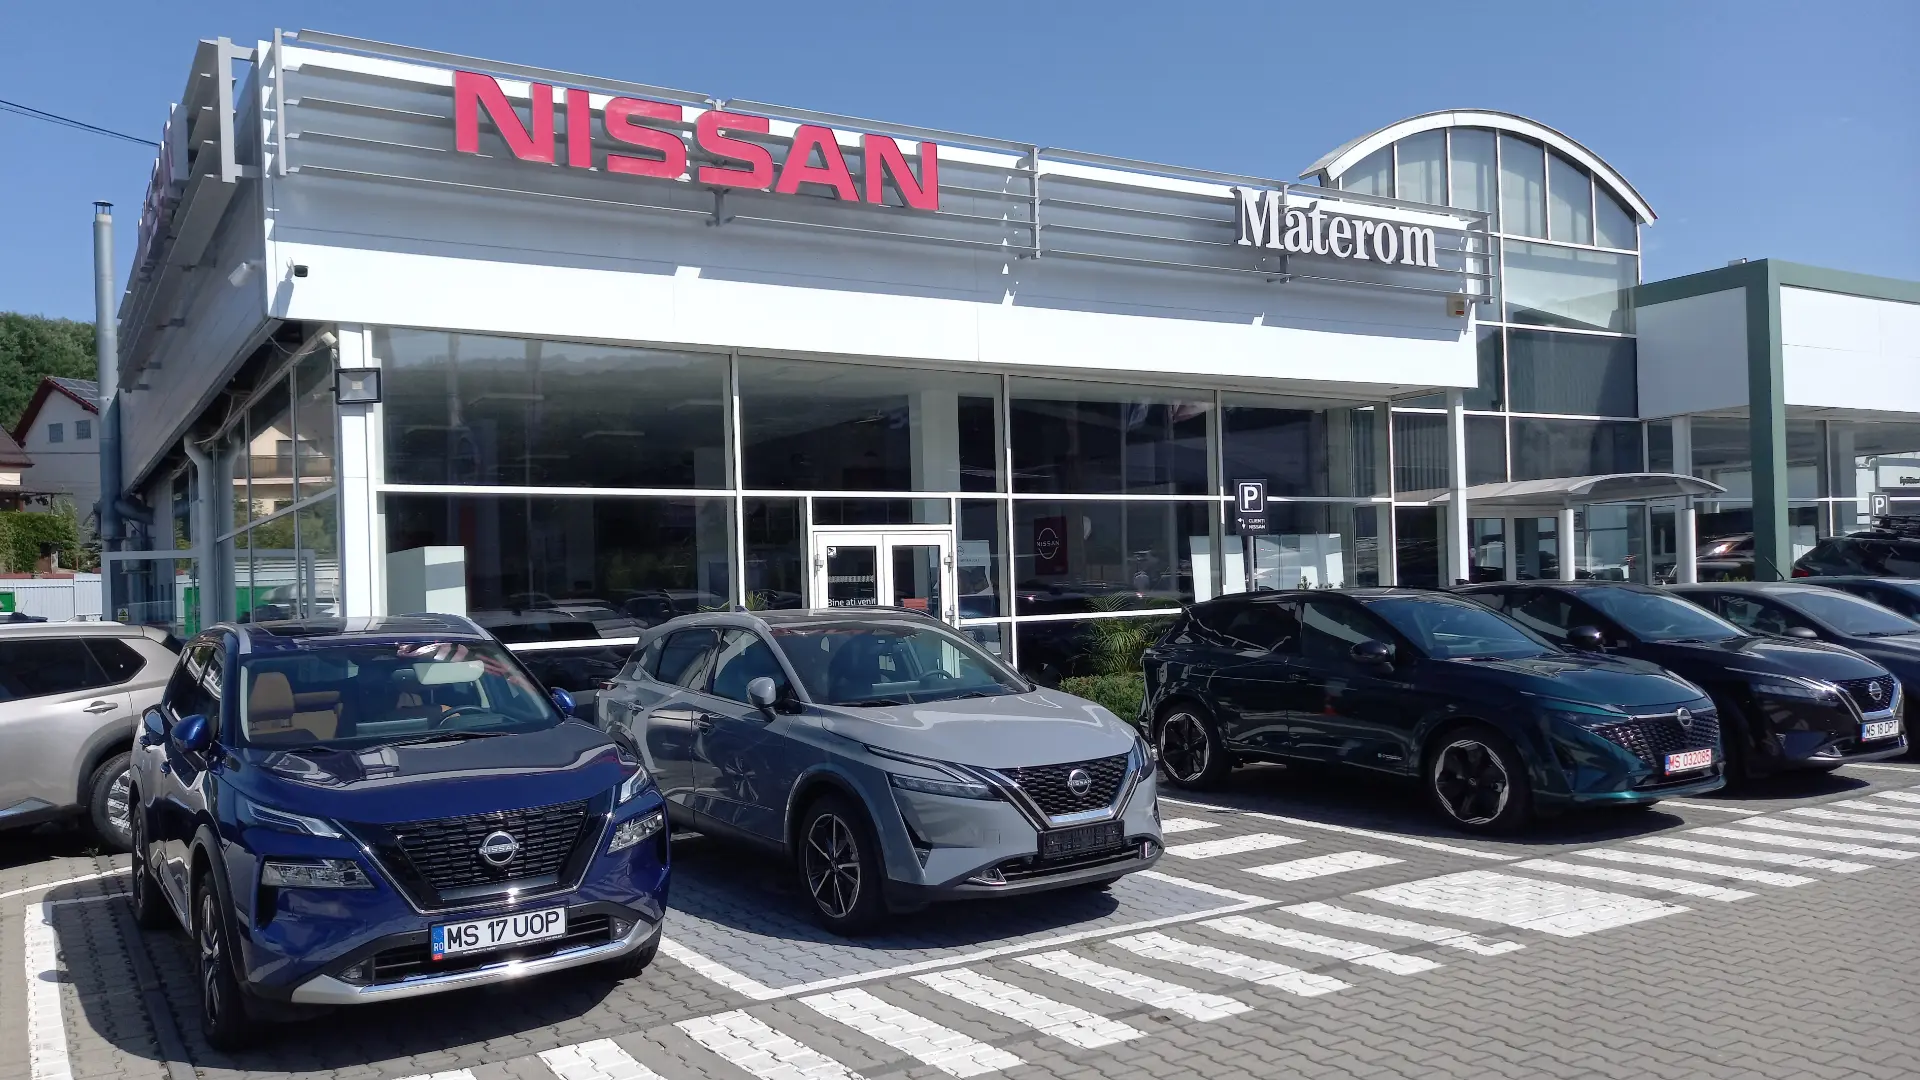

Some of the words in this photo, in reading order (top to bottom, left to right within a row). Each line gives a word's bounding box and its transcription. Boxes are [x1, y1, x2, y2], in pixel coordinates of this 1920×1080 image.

[455, 70, 939, 212] NISSAN
[1231, 186, 1439, 268] Materom
[1244, 486, 1258, 509] P
[1875, 497, 1885, 514] P
[828, 598, 844, 607] Bine
[857, 597, 876, 606] venit
[1669, 755, 1681, 769] MS
[479, 842, 520, 855] NISSAN
[447, 924, 479, 950] MS
[487, 918, 509, 943] 17
[513, 911, 560, 938] UOP
[433, 941, 444, 952] RO
